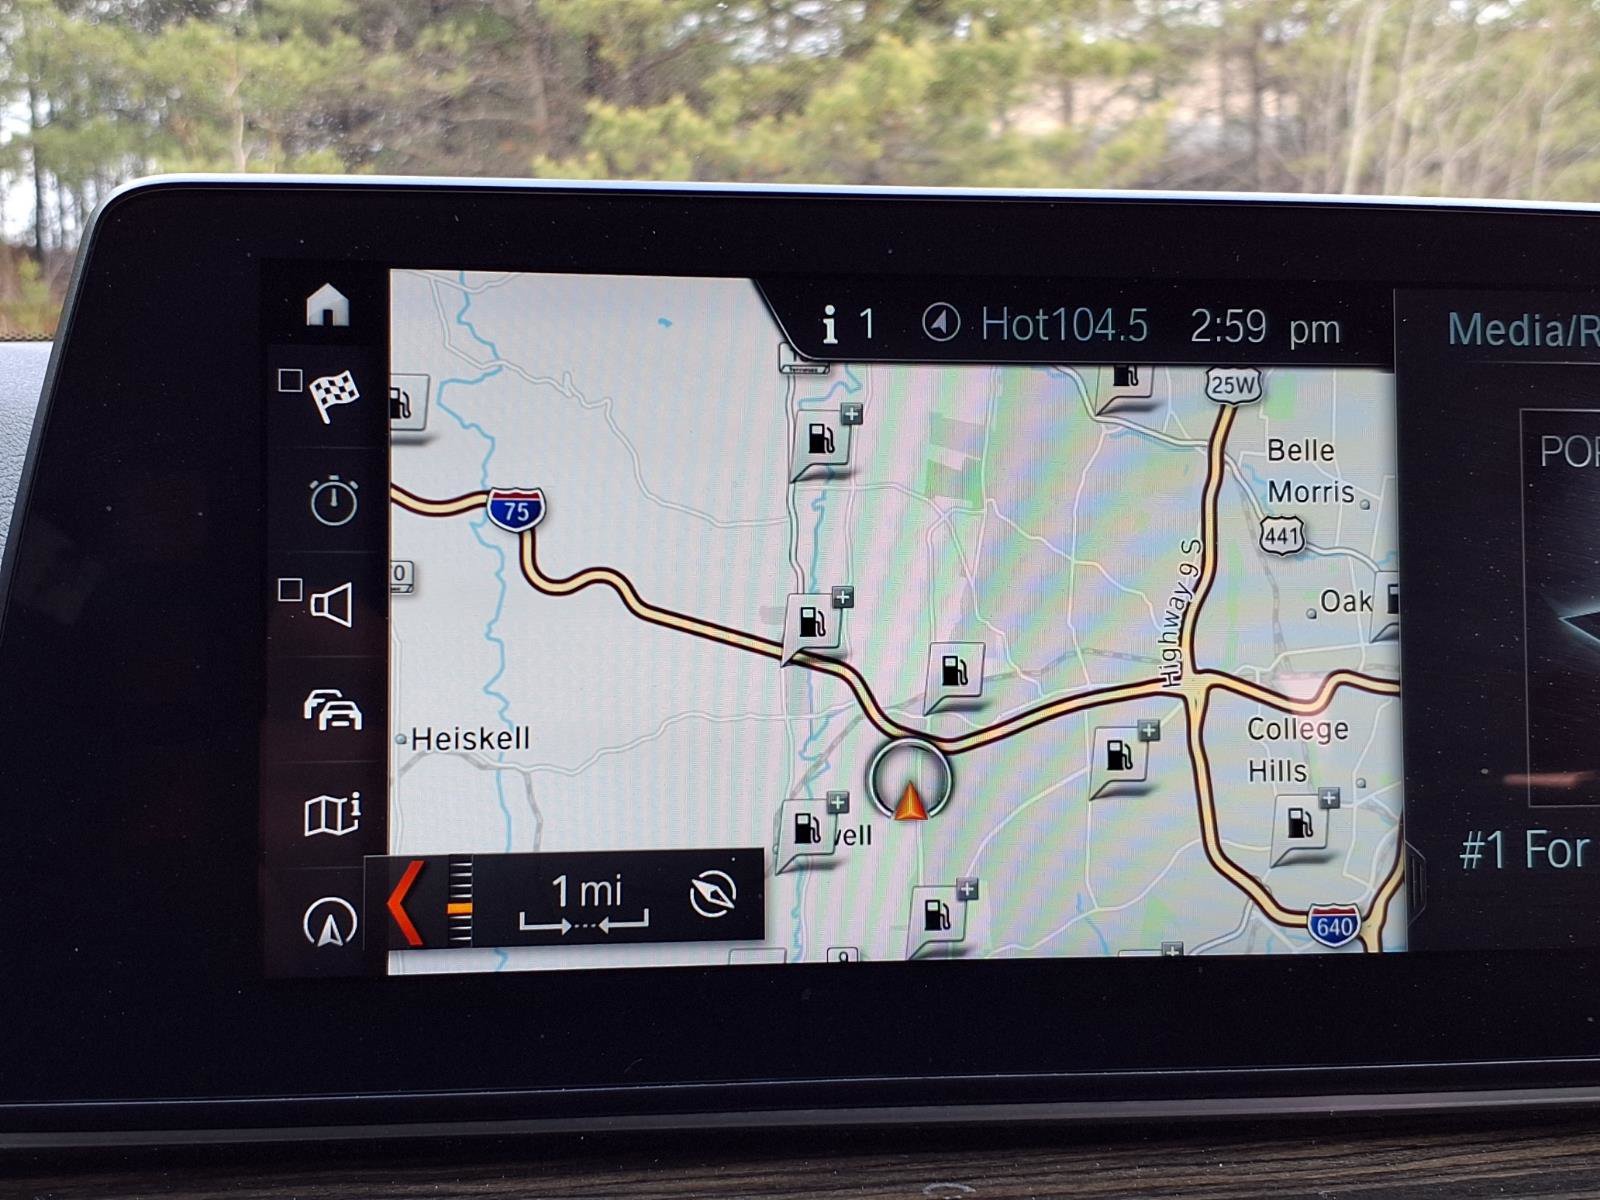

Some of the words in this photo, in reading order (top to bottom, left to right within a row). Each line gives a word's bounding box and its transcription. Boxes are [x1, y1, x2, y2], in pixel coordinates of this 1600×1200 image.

[982, 306, 1148, 342] Hot104.5
[1191, 308, 1266, 343] 2:59
[1290, 319, 1340, 350] pm
[1212, 376, 1255, 394] 25W
[1268, 438, 1335, 462] Belle
[1541, 434, 1600, 468] PO
[1268, 480, 1355, 503] Morris
[504, 502, 529, 521] 75
[1265, 527, 1297, 545] 441
[1321, 589, 1373, 612] Oak
[1157, 581, 1193, 688] Highway
[1181, 539, 1202, 554] S
[412, 726, 529, 751] Heiskell
[1248, 716, 1349, 745] College
[1249, 759, 1308, 782] Hills
[1460, 830, 1502, 869] #1
[1526, 829, 1591, 869] For
[552, 874, 567, 907] 1
[581, 873, 621, 907] mi
[1317, 917, 1353, 936] 640
